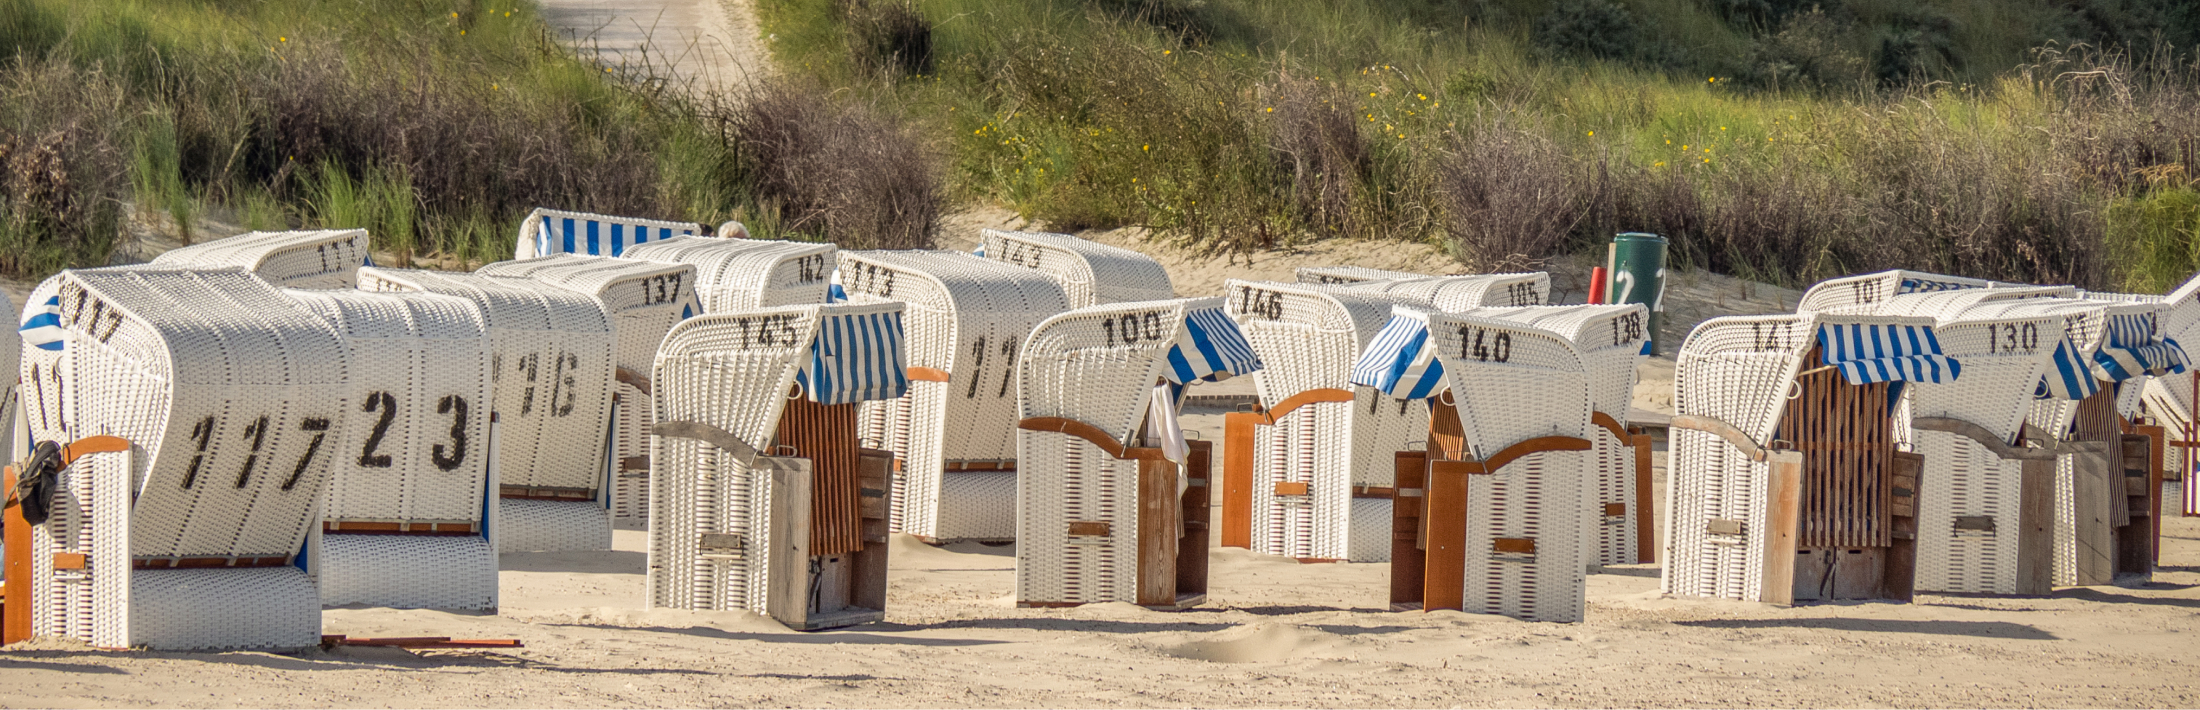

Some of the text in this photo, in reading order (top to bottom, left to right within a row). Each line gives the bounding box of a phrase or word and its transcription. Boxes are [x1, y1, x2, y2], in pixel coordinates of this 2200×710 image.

[798, 254, 824, 284] 142
[1000, 237, 1043, 268] 143
[642, 273, 682, 305] 137
[853, 260, 894, 298] 113
[1508, 280, 1540, 306] 105
[71, 287, 124, 345] 117
[1242, 285, 1283, 321] 146
[739, 316, 797, 350] 145
[1102, 309, 1161, 348] 100
[1457, 323, 1512, 363] 140
[1612, 310, 1641, 346] 138
[1989, 320, 2038, 354] 130
[180, 414, 331, 491] 117
